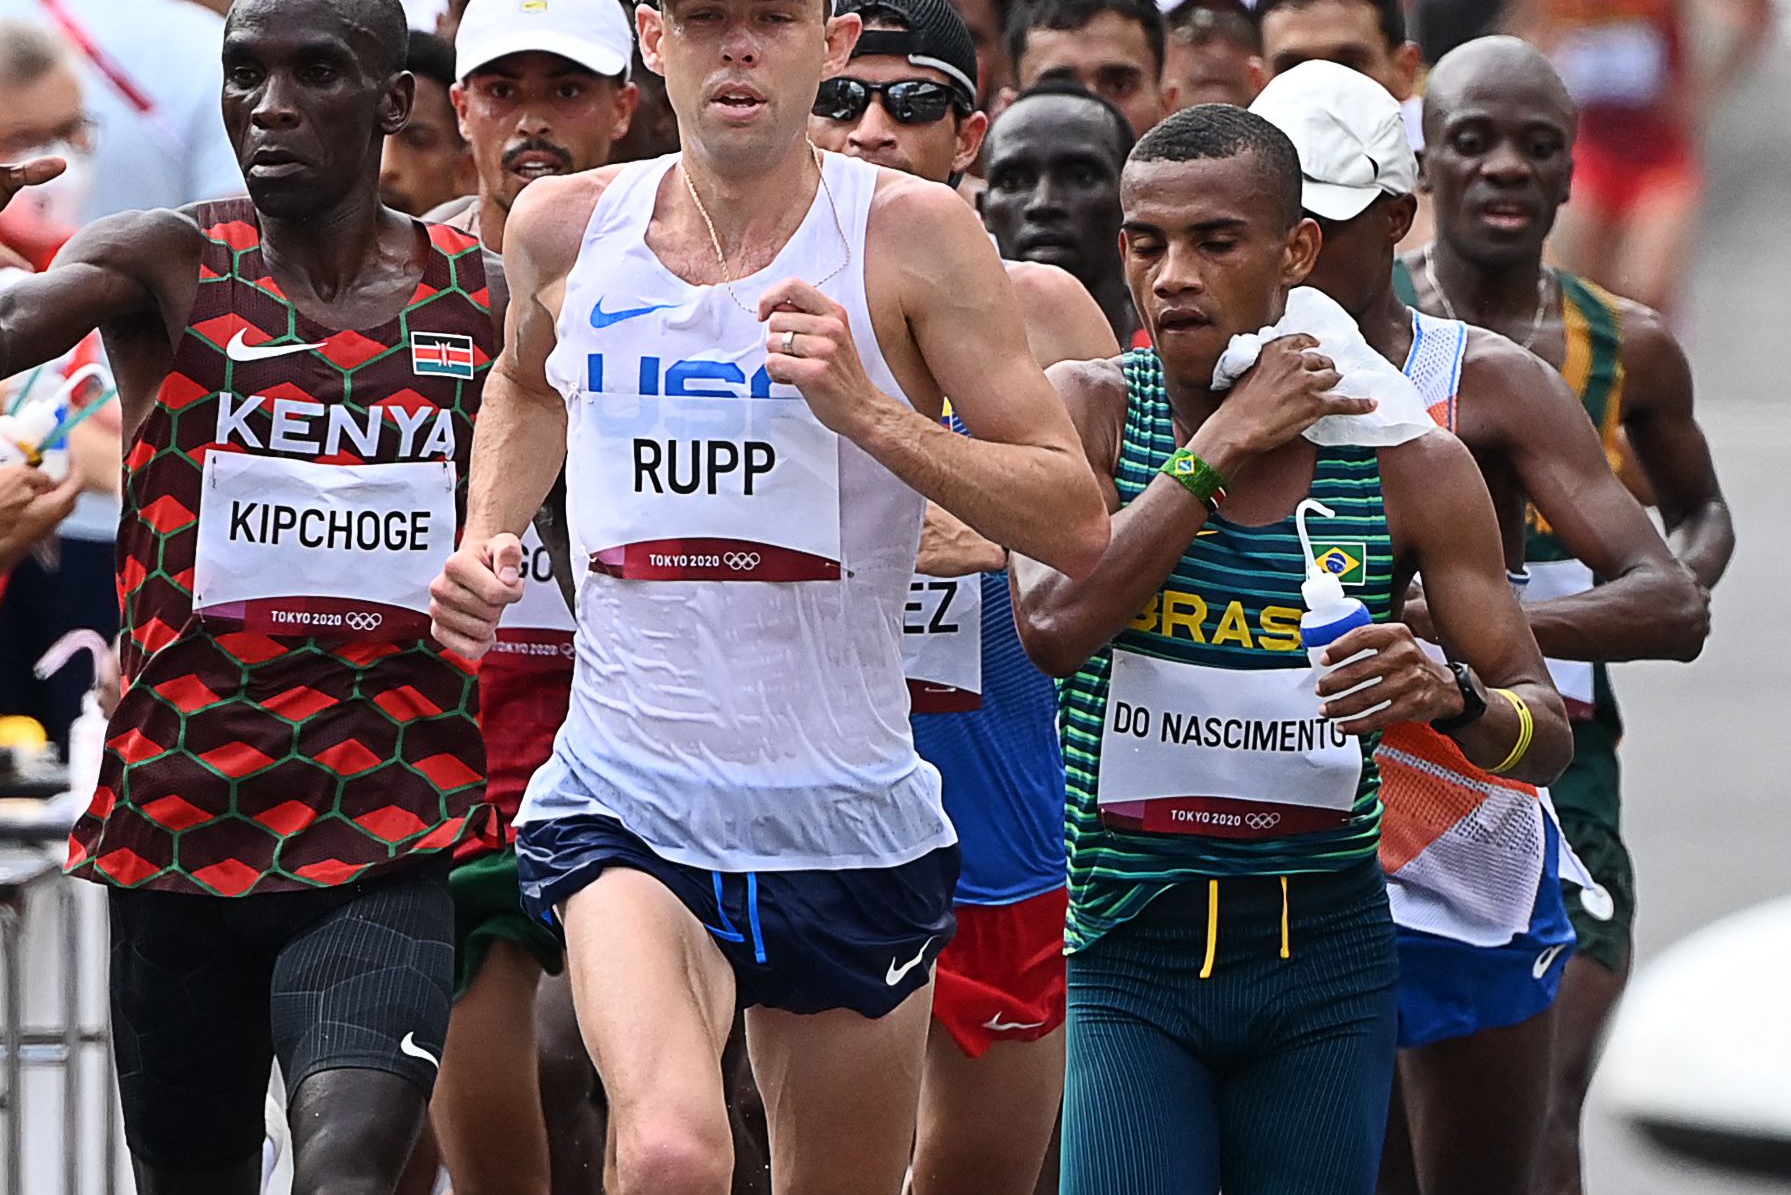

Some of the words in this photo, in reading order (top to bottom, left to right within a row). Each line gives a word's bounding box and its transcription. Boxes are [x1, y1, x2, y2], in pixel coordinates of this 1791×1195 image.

[215, 392, 456, 461] KENYA
[633, 438, 776, 496] RUPP
[229, 501, 431, 551] KIPCHOGE
[648, 553, 687, 567] TOKYO
[690, 554, 720, 567] 2020
[271, 610, 311, 625] TOKYO
[312, 612, 342, 626] 2020
[1113, 701, 1150, 738] DO
[1170, 809, 1210, 823] TOKYO
[1212, 810, 1241, 826] 2020
